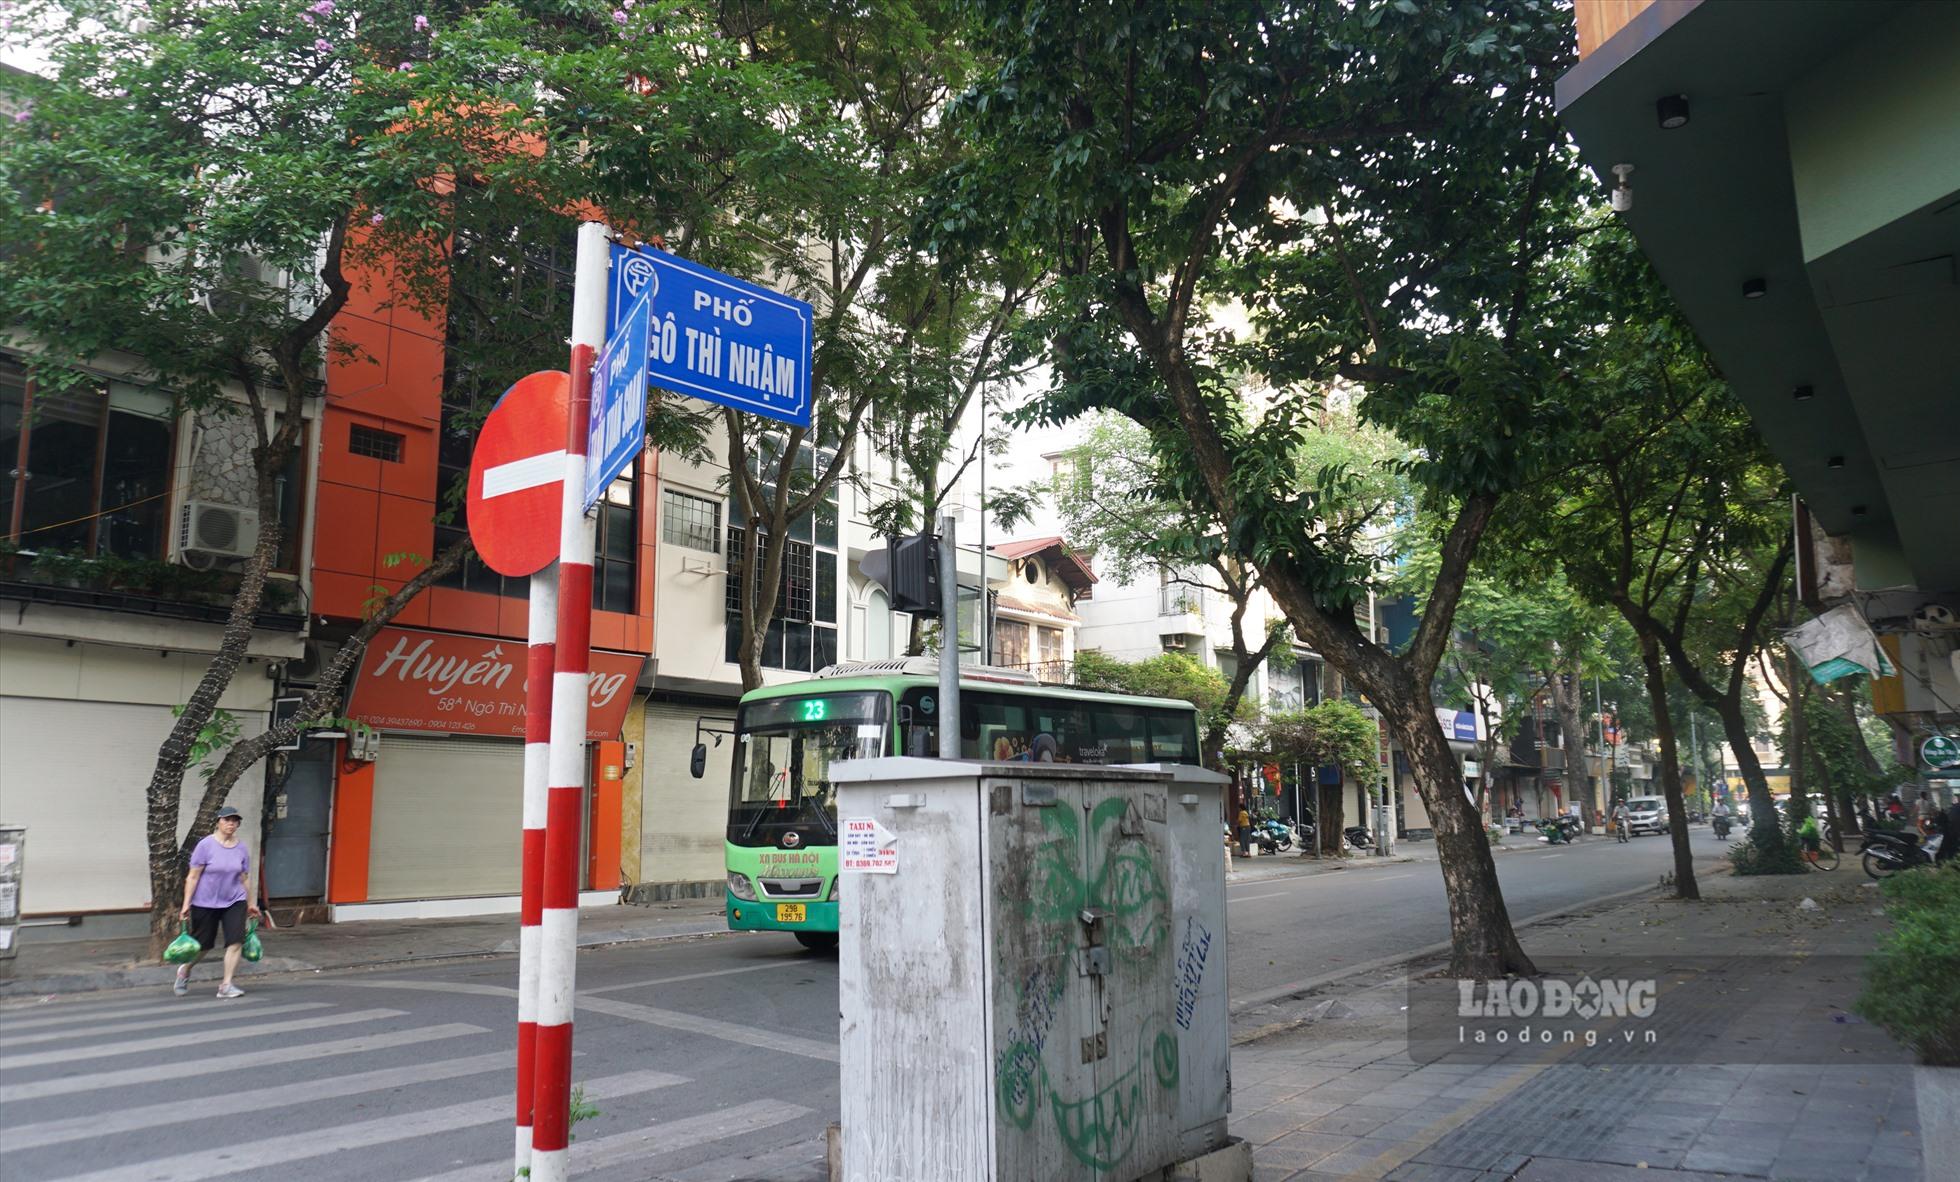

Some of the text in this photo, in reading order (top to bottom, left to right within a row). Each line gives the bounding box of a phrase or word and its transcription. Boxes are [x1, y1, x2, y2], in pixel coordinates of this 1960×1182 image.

[693, 289, 756, 327] PHỐ
[610, 324, 632, 386] PHỐ
[650, 312, 795, 401] GÔ THÌ NHẬM
[373, 635, 513, 696] Huyền
[464, 700, 495, 716] Ngô
[805, 700, 824, 720] 23
[849, 823, 865, 831] TAXI
